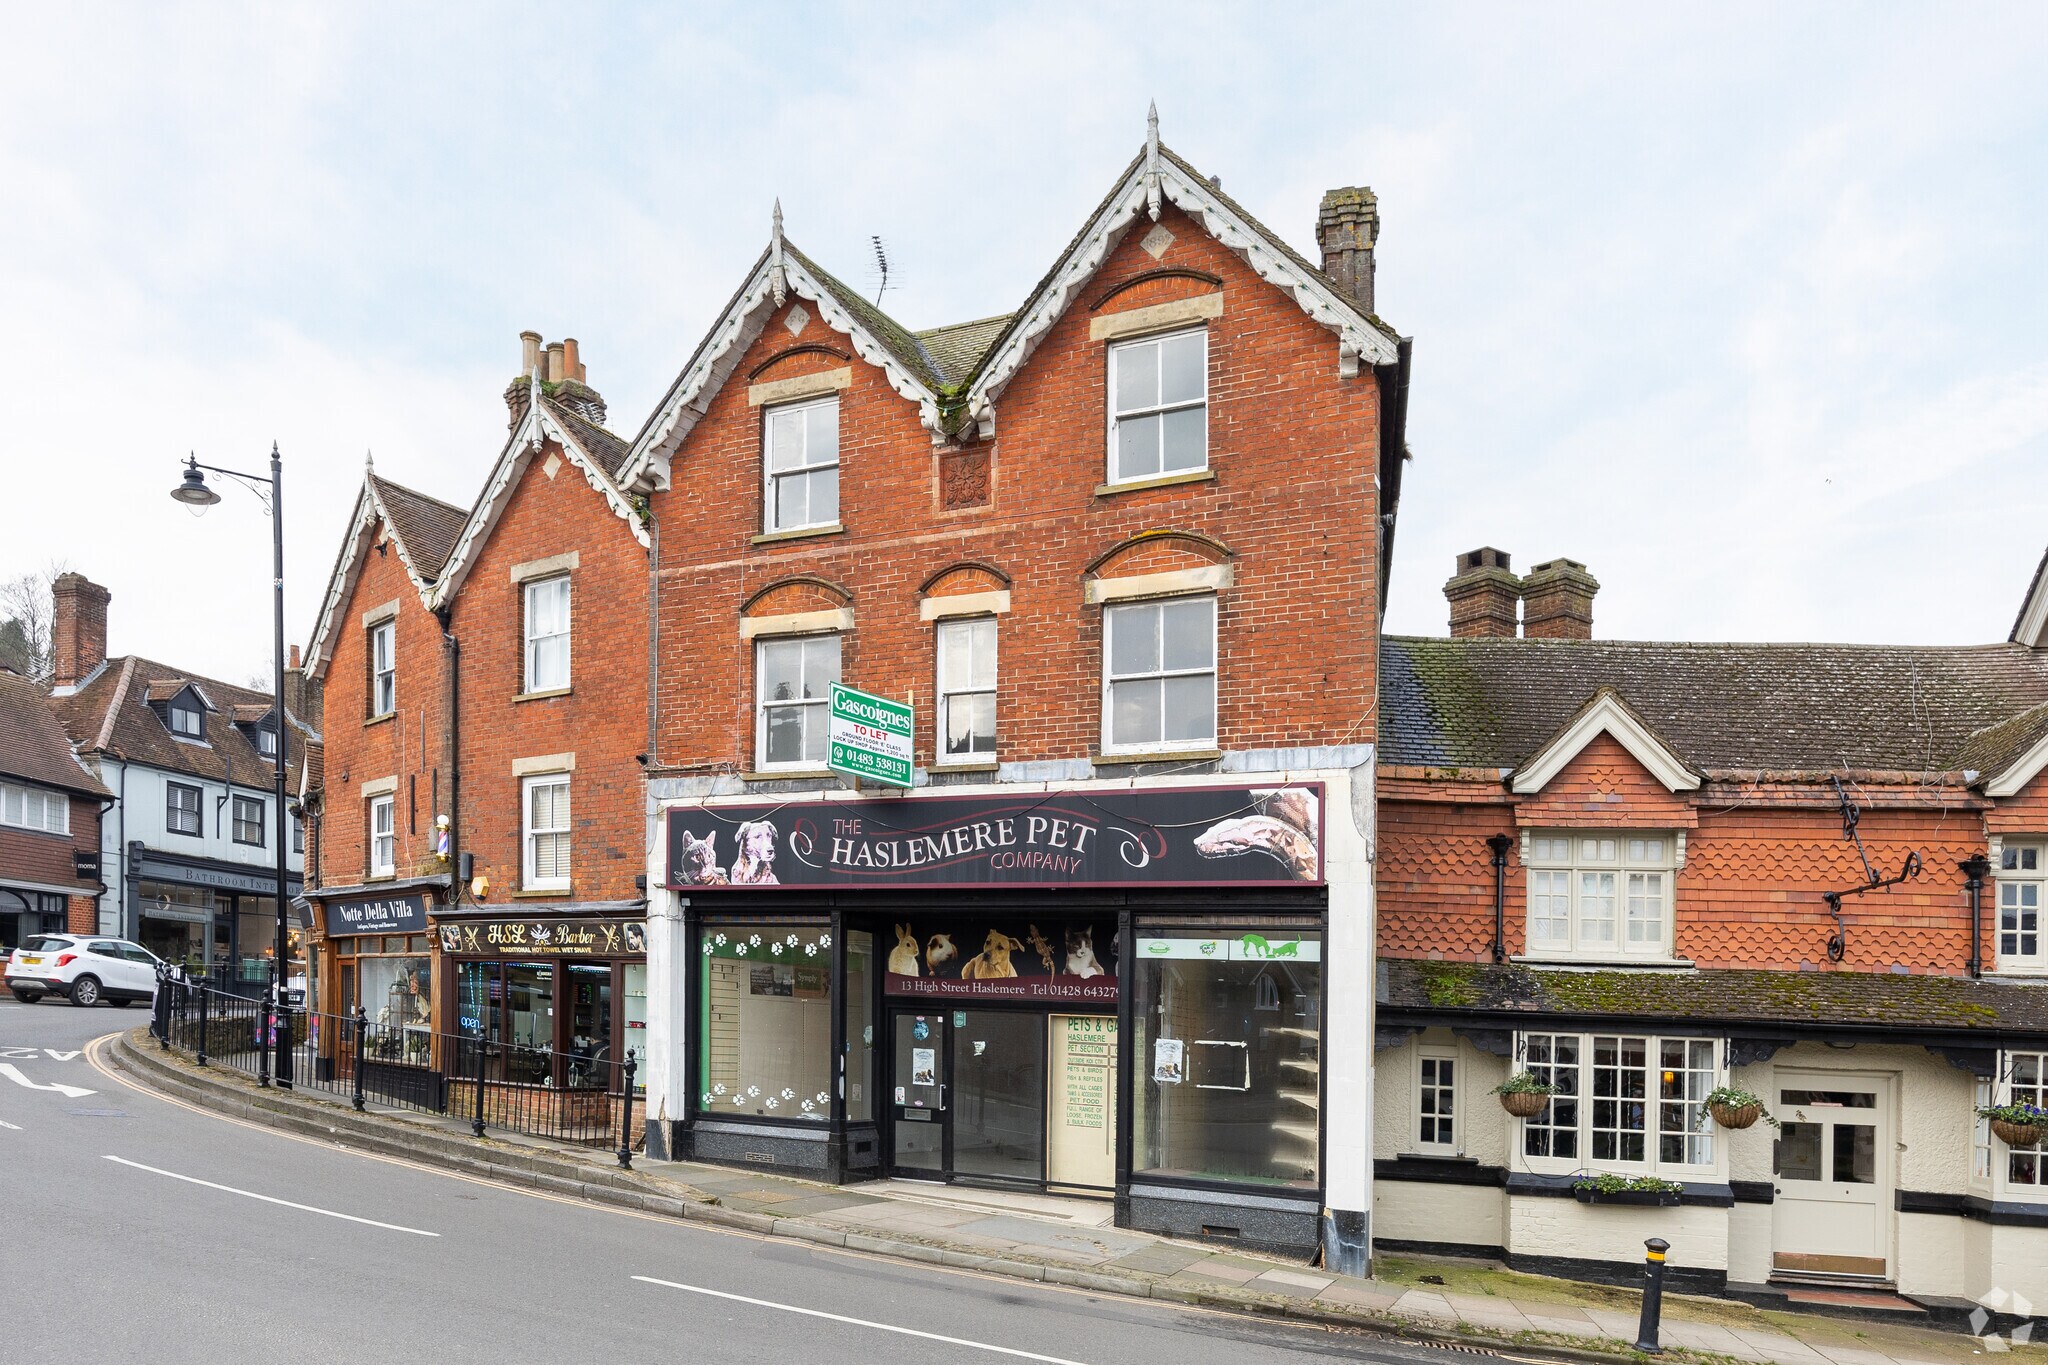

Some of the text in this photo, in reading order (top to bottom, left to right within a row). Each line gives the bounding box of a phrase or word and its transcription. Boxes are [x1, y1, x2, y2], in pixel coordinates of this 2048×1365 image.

[834, 690, 910, 730] Gascoignes
[853, 724, 889, 741] TO LET
[842, 731, 863, 742] GROUND
[863, 737, 879, 746] FLOOR
[886, 743, 902, 752] CLASS
[855, 740, 869, 749] SHOP
[847, 749, 907, 775] 01483 538131
[851, 762, 902, 779] www.gascoignes.com
[833, 818, 862, 835] THE
[830, 816, 1097, 868] HASLEMERE PET
[990, 851, 1082, 875] COMPANY
[185, 869, 247, 888] BATHROOM
[340, 900, 413, 922] Notte Della Villa
[487, 923, 596, 945] HSL Barber
[901, 981, 912, 991] 13
[914, 981, 939, 993] High
[941, 982, 969, 993] Street
[972, 982, 1025, 995] Haslemere
[1031, 983, 1047, 995] Tel
[1050, 984, 1081, 996] 01428
[461, 1016, 480, 1029] open
[1067, 1017, 1091, 1032] PETS
[1095, 1018, 1102, 1032] &
[1067, 1033, 1106, 1043] HASLEMERE
[1067, 1044, 1104, 1054] PET SECTION
